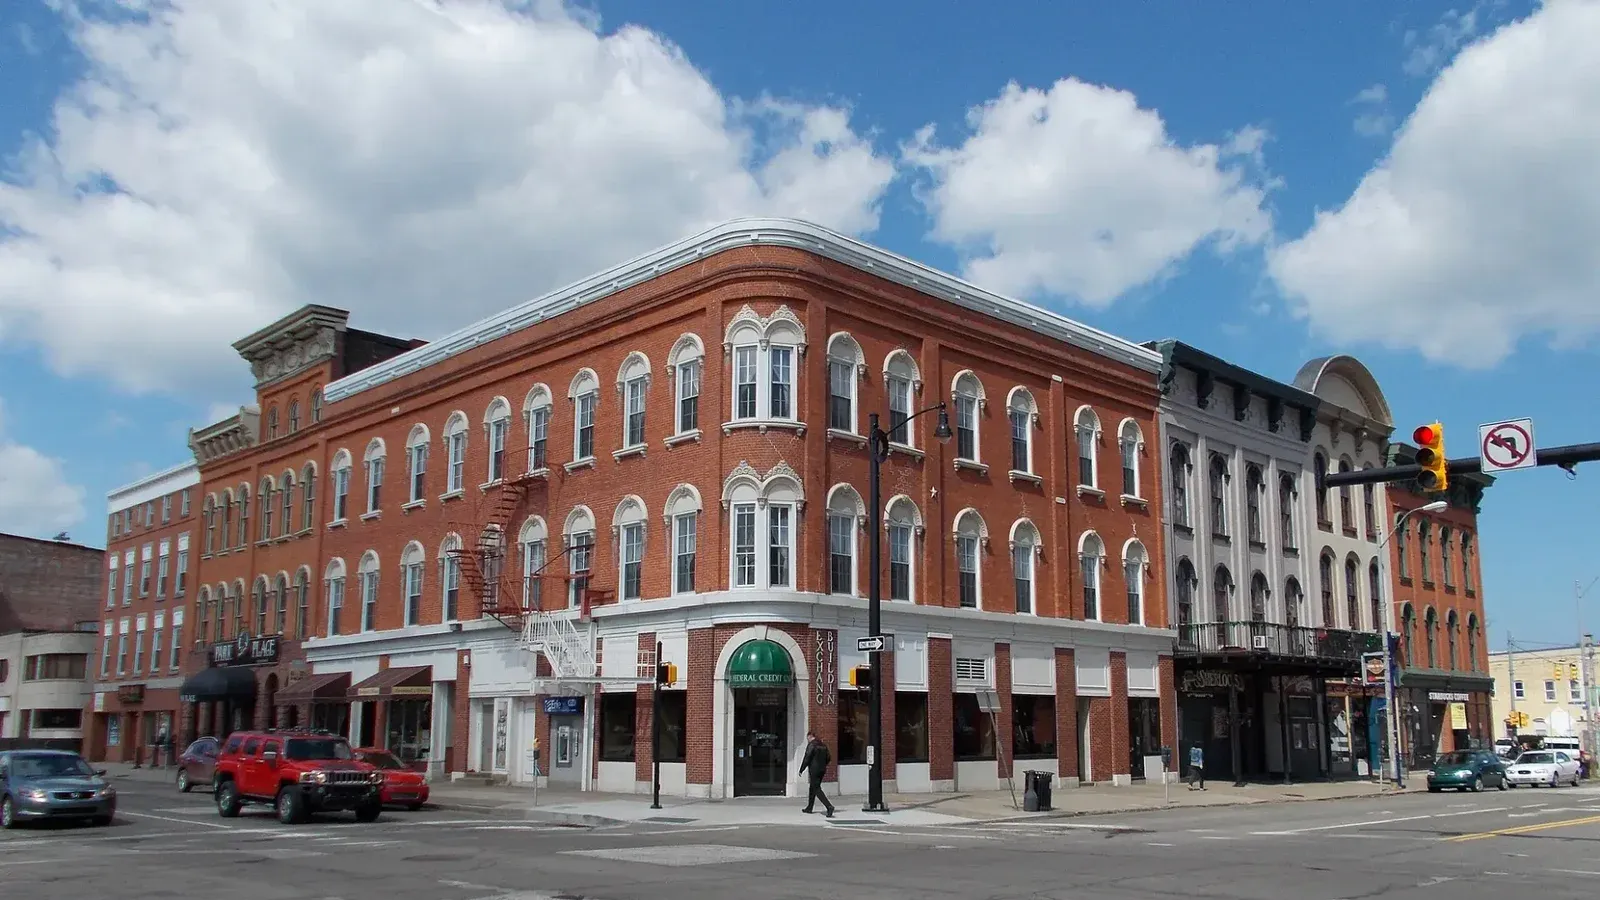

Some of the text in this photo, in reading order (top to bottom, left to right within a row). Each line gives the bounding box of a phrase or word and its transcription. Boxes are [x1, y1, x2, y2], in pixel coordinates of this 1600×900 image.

[214, 639, 276, 662] PARK PLACE
[758, 674, 783, 682] CREDIT
[1429, 692, 1469, 701] STARBUCKS COFFEE
